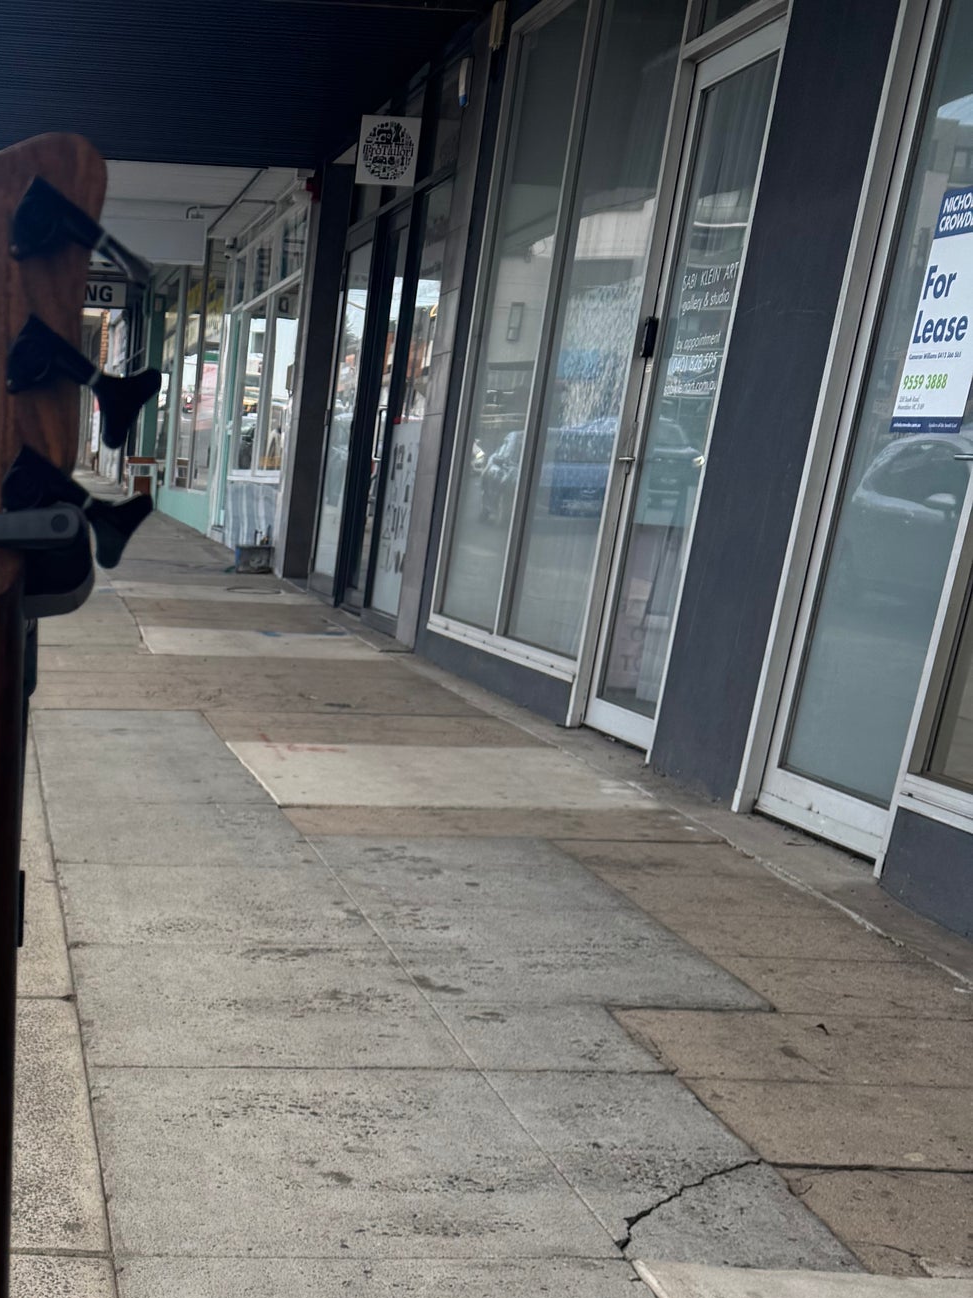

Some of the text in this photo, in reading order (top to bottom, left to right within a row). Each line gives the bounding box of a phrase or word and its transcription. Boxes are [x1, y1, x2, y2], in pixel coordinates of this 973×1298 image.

[700, 267, 721, 286] KLEIN
[723, 262, 739, 281] ART
[922, 265, 957, 300] For
[84, 284, 113, 302] NG
[682, 294, 702, 316] gallery
[710, 287, 730, 306] studio
[912, 310, 969, 344] Lease
[676, 330, 721, 352] by appointment
[703, 351, 718, 369] 595
[903, 373, 948, 390] 9559 3888
